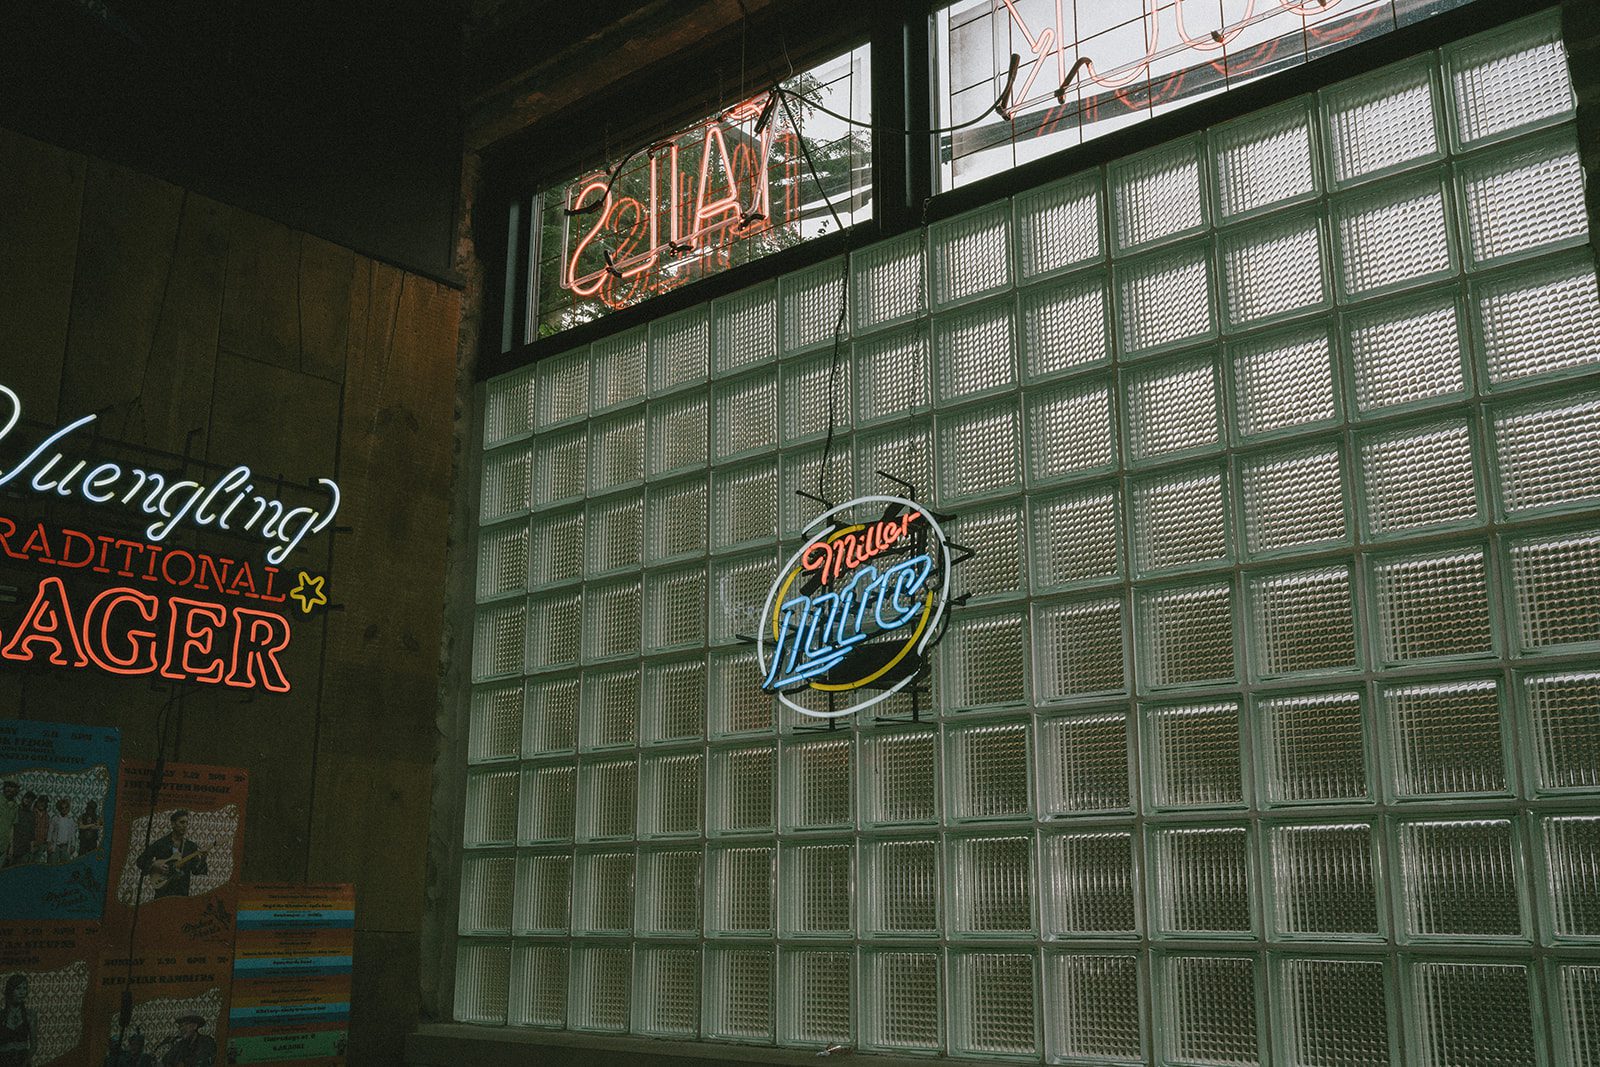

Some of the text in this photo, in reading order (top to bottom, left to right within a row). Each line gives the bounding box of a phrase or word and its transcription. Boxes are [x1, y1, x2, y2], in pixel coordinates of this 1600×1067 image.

[802, 511, 922, 585] Miller
[0, 576, 291, 693] AGER
[762, 554, 933, 688] Lite
